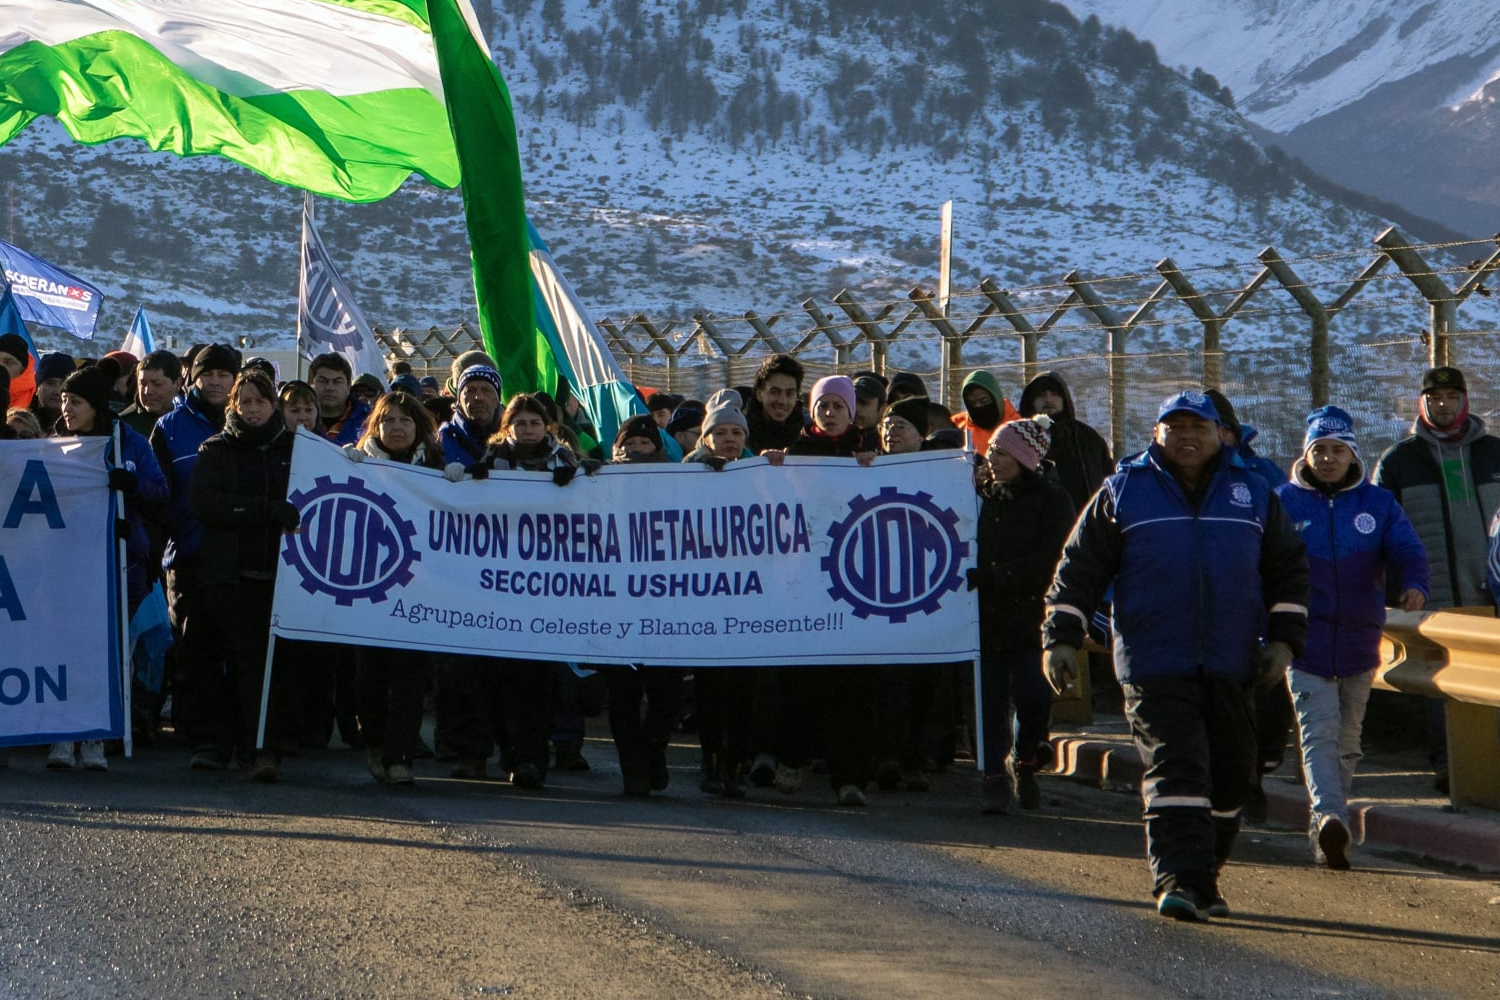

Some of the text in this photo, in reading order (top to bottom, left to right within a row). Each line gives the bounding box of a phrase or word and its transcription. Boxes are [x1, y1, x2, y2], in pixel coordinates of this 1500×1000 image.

[427, 502, 812, 564] UNION OBRERA METALURGICA
[478, 567, 764, 598] SECCIONAL USHUAIA
[389, 597, 844, 640] Agrupacion Celeste y Blanca Presente!!!
